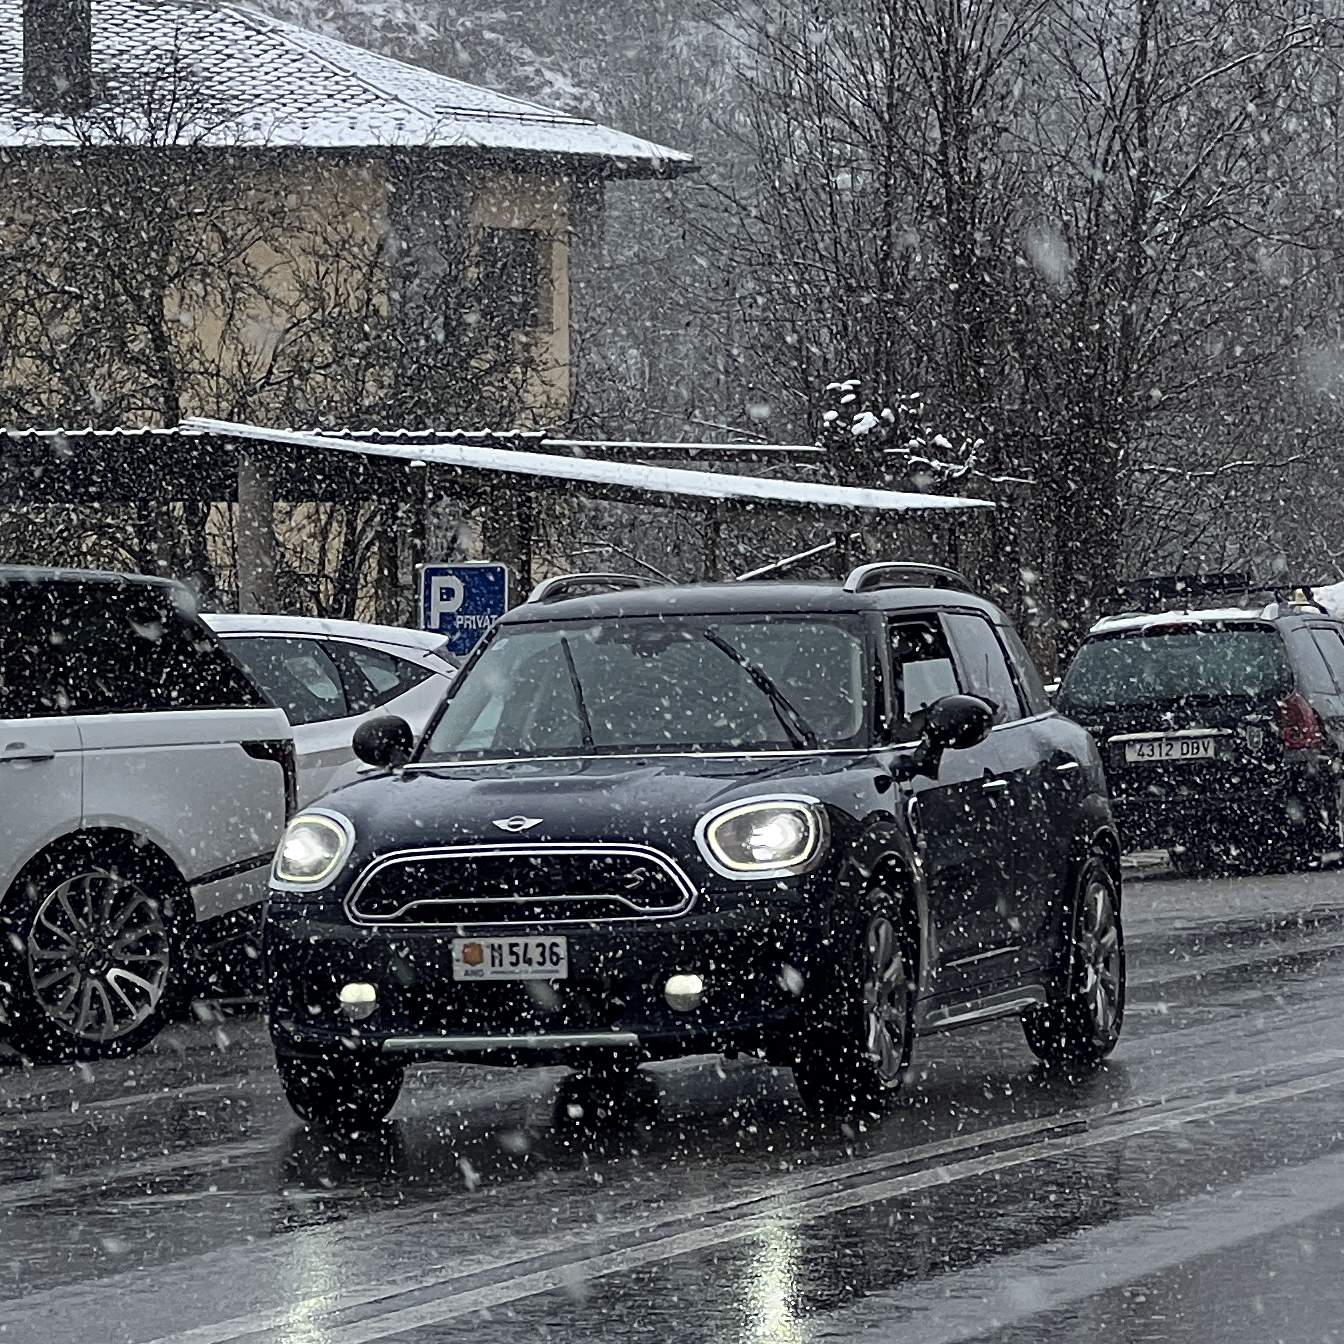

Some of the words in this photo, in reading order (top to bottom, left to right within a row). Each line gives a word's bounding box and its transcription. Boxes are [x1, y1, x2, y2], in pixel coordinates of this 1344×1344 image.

[431, 576, 464, 629] P
[1137, 742, 1174, 758] 4312
[1180, 740, 1210, 756] DBV
